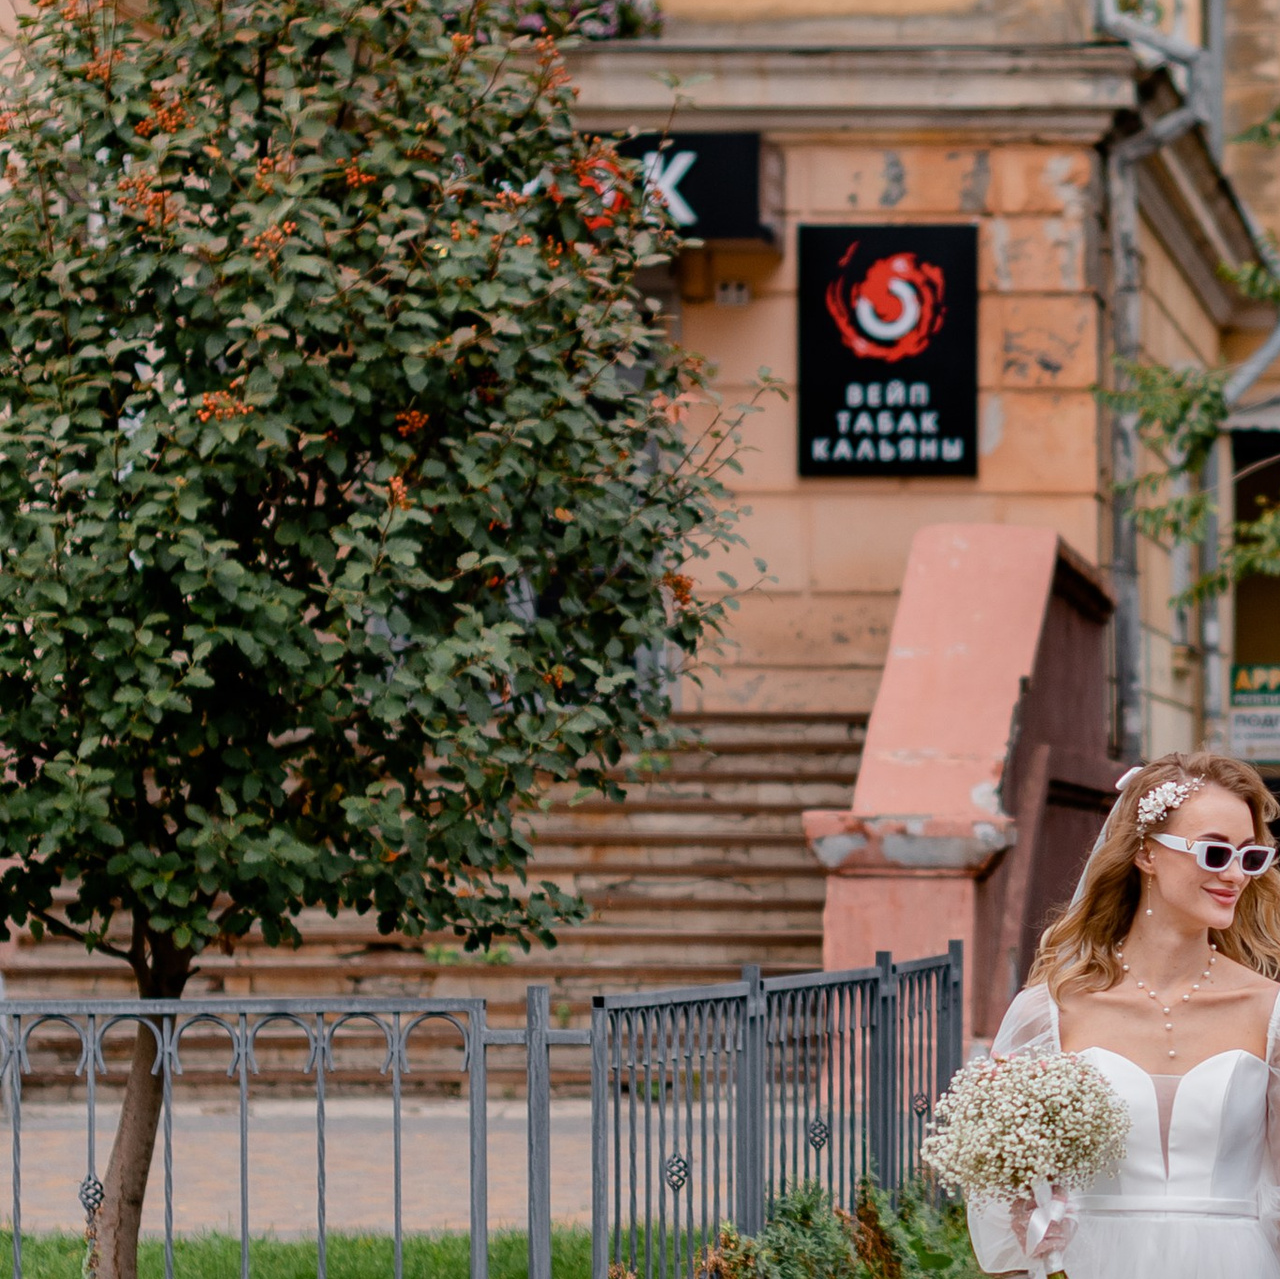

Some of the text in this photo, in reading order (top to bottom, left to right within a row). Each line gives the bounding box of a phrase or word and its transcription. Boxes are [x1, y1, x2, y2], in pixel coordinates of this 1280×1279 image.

[846, 378, 930, 407] ВЕЙП
[836, 410, 939, 435] ТАБАК
[812, 437, 964, 462] КАЛЬЯНЫ
